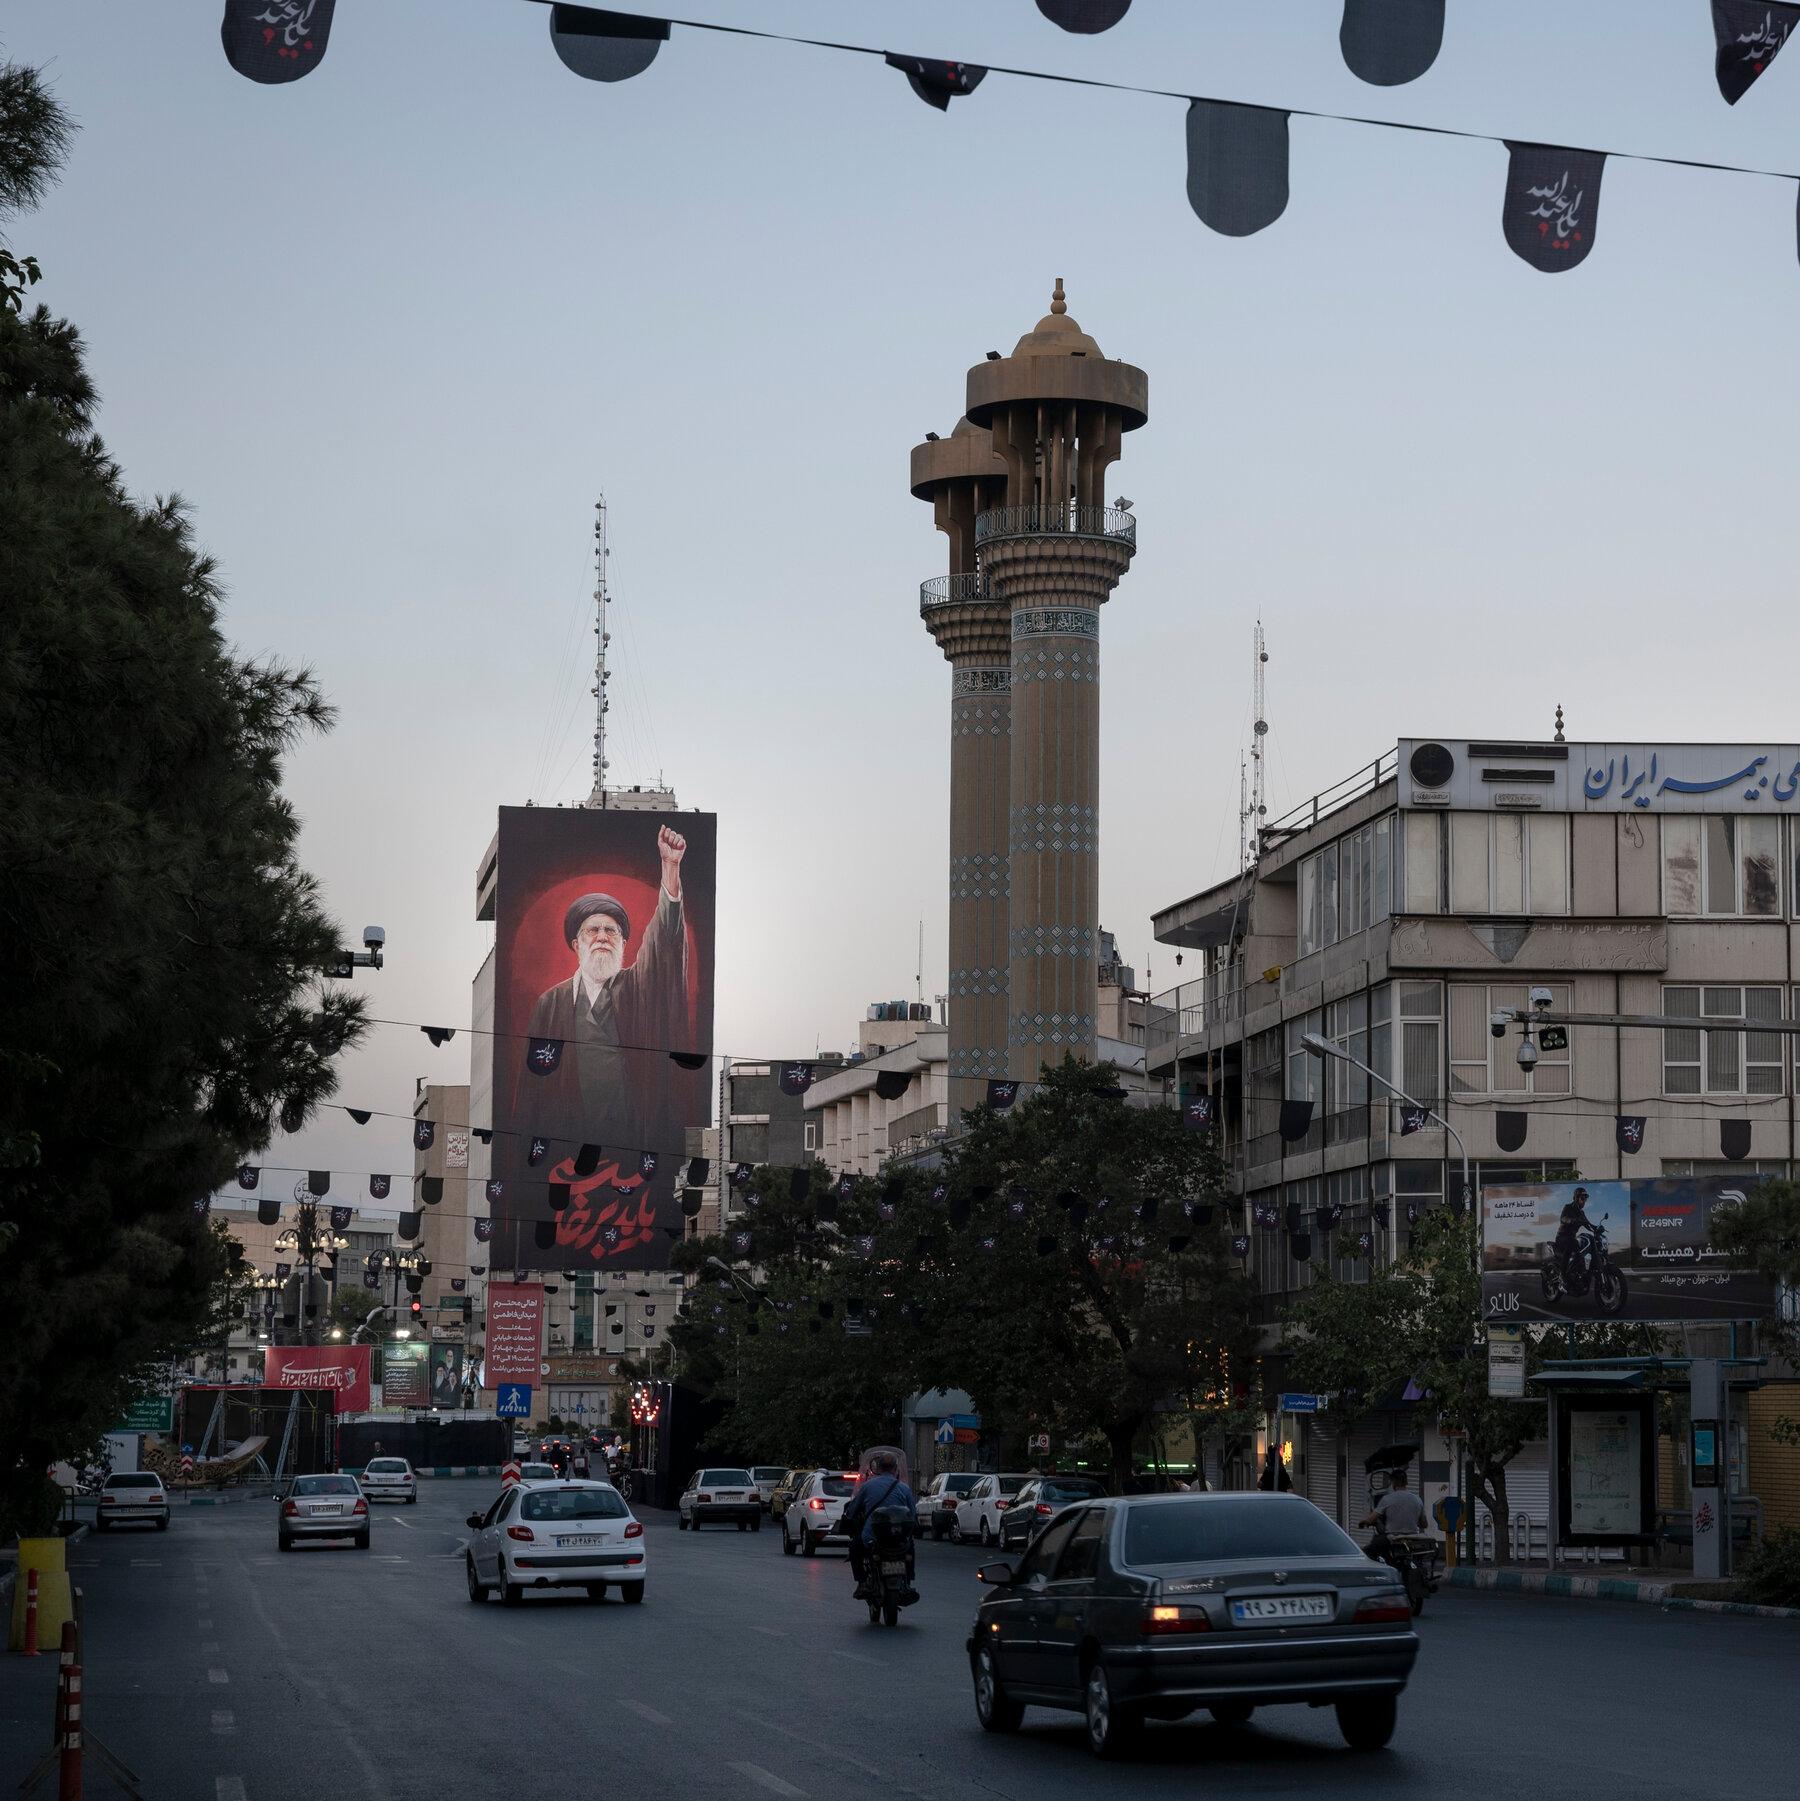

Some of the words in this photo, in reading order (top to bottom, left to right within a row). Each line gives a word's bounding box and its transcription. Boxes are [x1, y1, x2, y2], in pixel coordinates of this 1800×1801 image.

[1583, 752, 1657, 808] ایران
[1656, 755, 1768, 800] بیمه
[1517, 1201, 1535, 1209] اقساط
[1495, 1211, 1513, 1220] تخفیف
[1514, 1212, 1529, 1220] درصد
[1641, 1242, 1694, 1262] همیشه
[1660, 1274, 1675, 1286] میلاد
[1676, 1276, 1687, 1287] برج
[1692, 1274, 1709, 1285] تهران
[493, 1299, 521, 1309] محترم
[521, 1299, 538, 1309] اهالی
[493, 1309, 518, 1320] فاطمی
[517, 1310, 536, 1320] میدان
[492, 1334, 512, 1342] خیابانی
[512, 1335, 535, 1343] تجمعات
[514, 1345, 535, 1353] میدان
[1245, 1602, 1264, 1616] ۹۹
[1266, 1602, 1277, 1615] د
